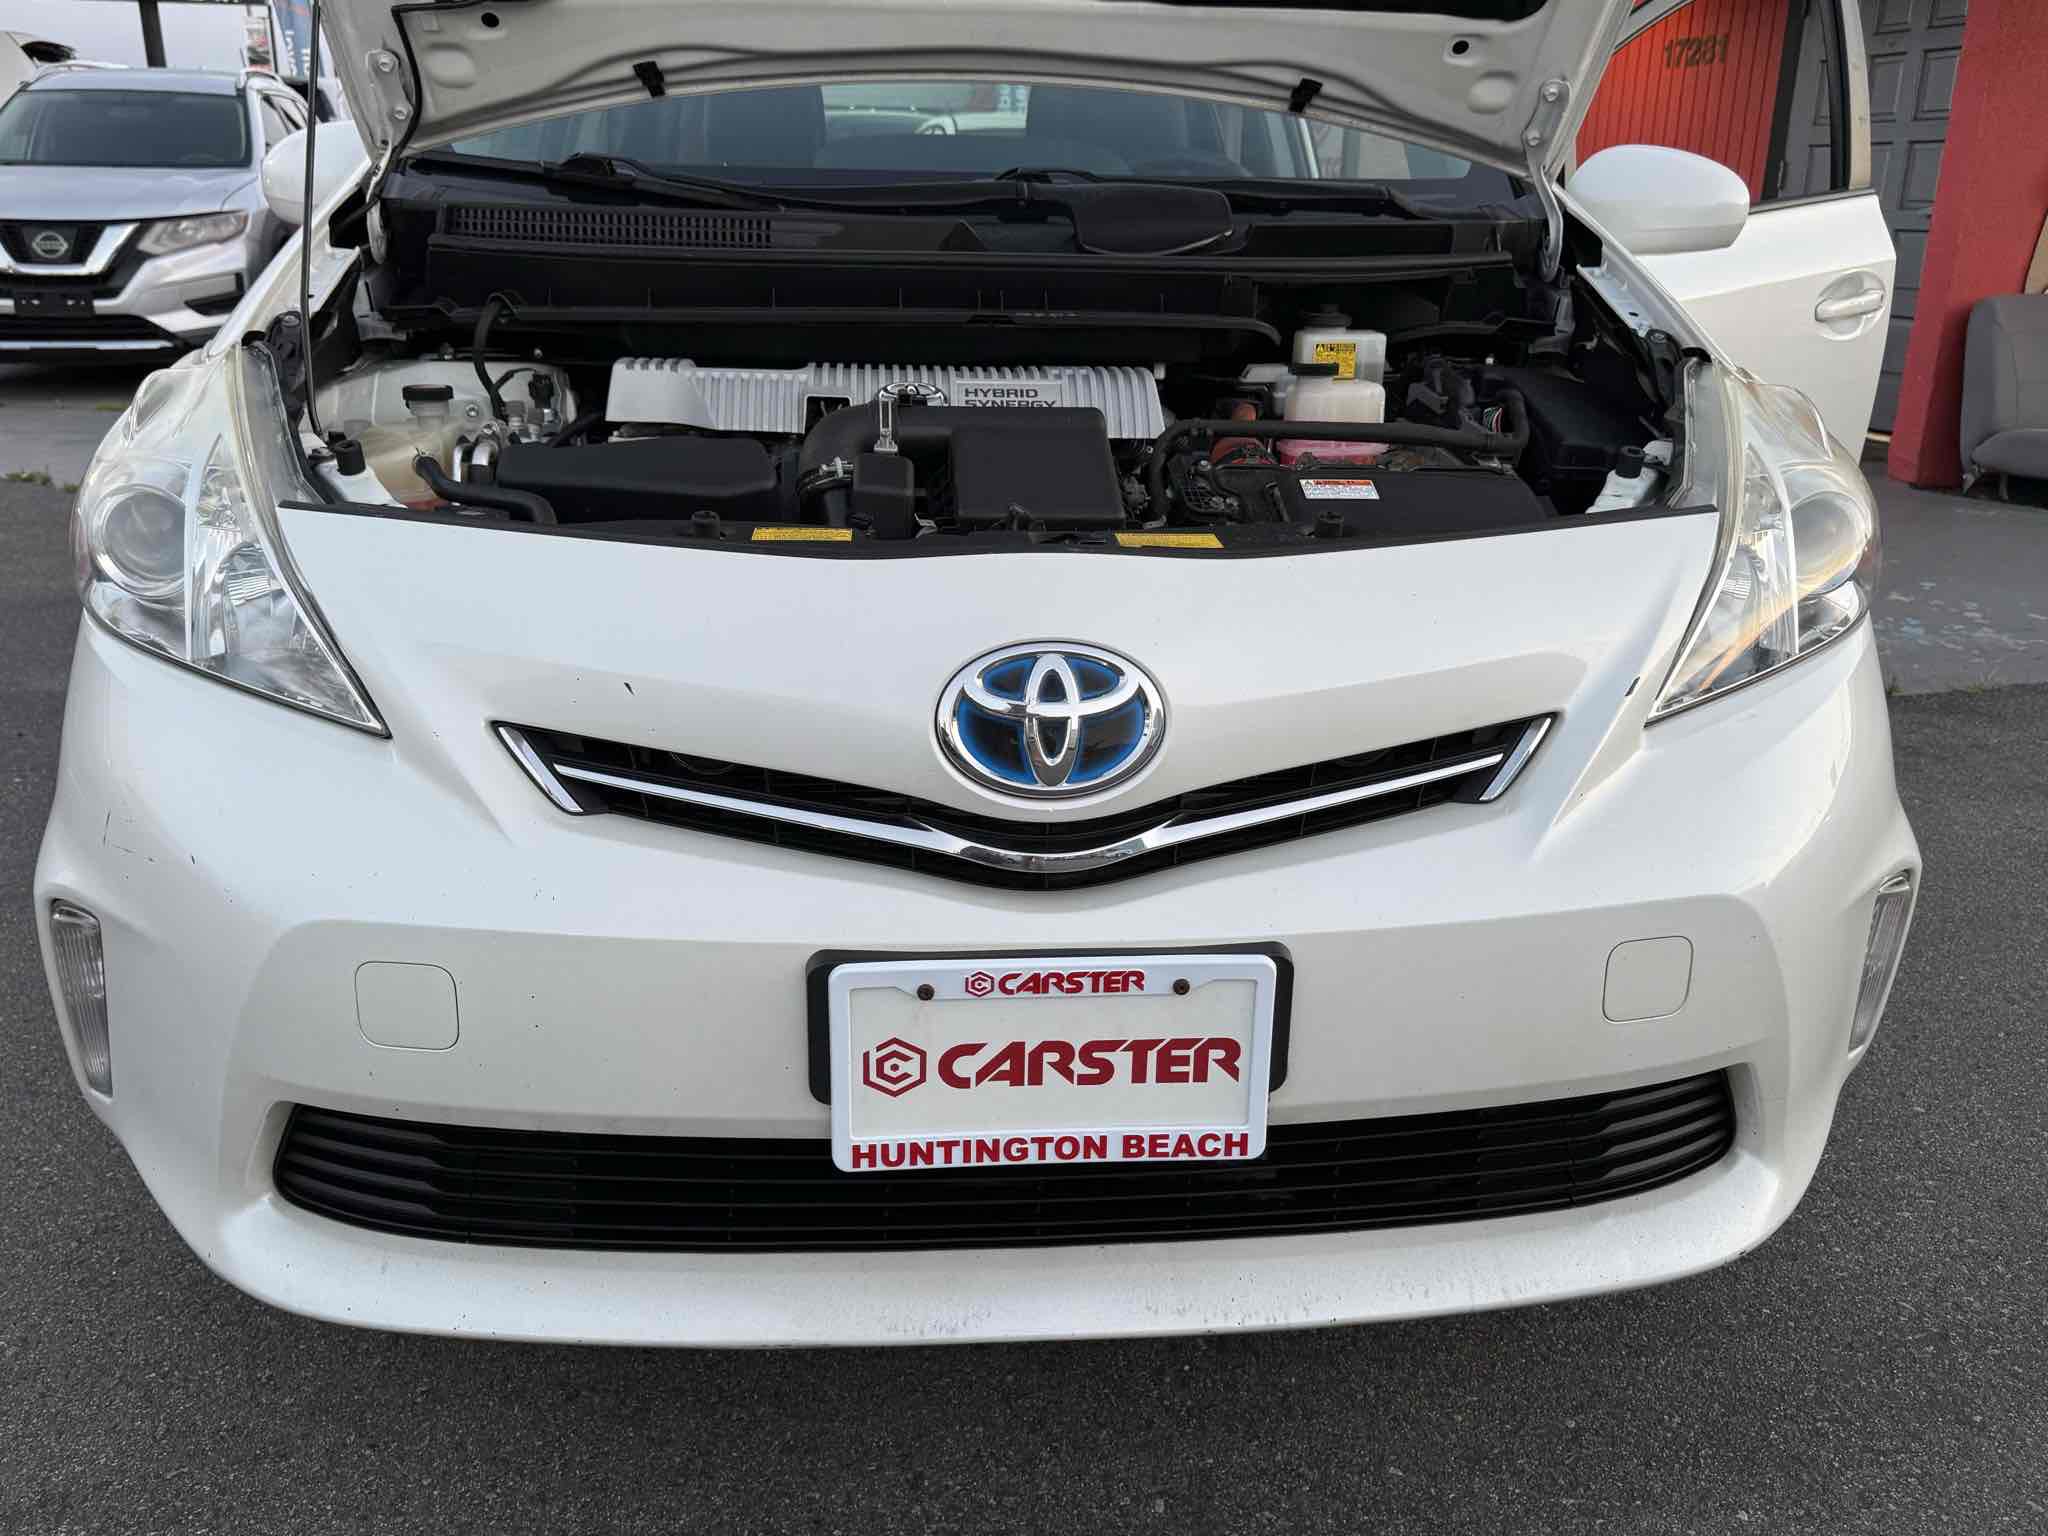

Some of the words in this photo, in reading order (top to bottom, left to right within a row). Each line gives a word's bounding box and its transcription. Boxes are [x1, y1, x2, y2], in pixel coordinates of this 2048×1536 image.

[964, 387, 1038, 399] HYBRID
[964, 399, 1057, 408] SYNERGY
[998, 970, 1145, 995] CARSTER
[938, 1037, 1242, 1089] CARSTER
[851, 1135, 1108, 1169] HUNTINGTON
[1122, 1133, 1249, 1158] BEACH
